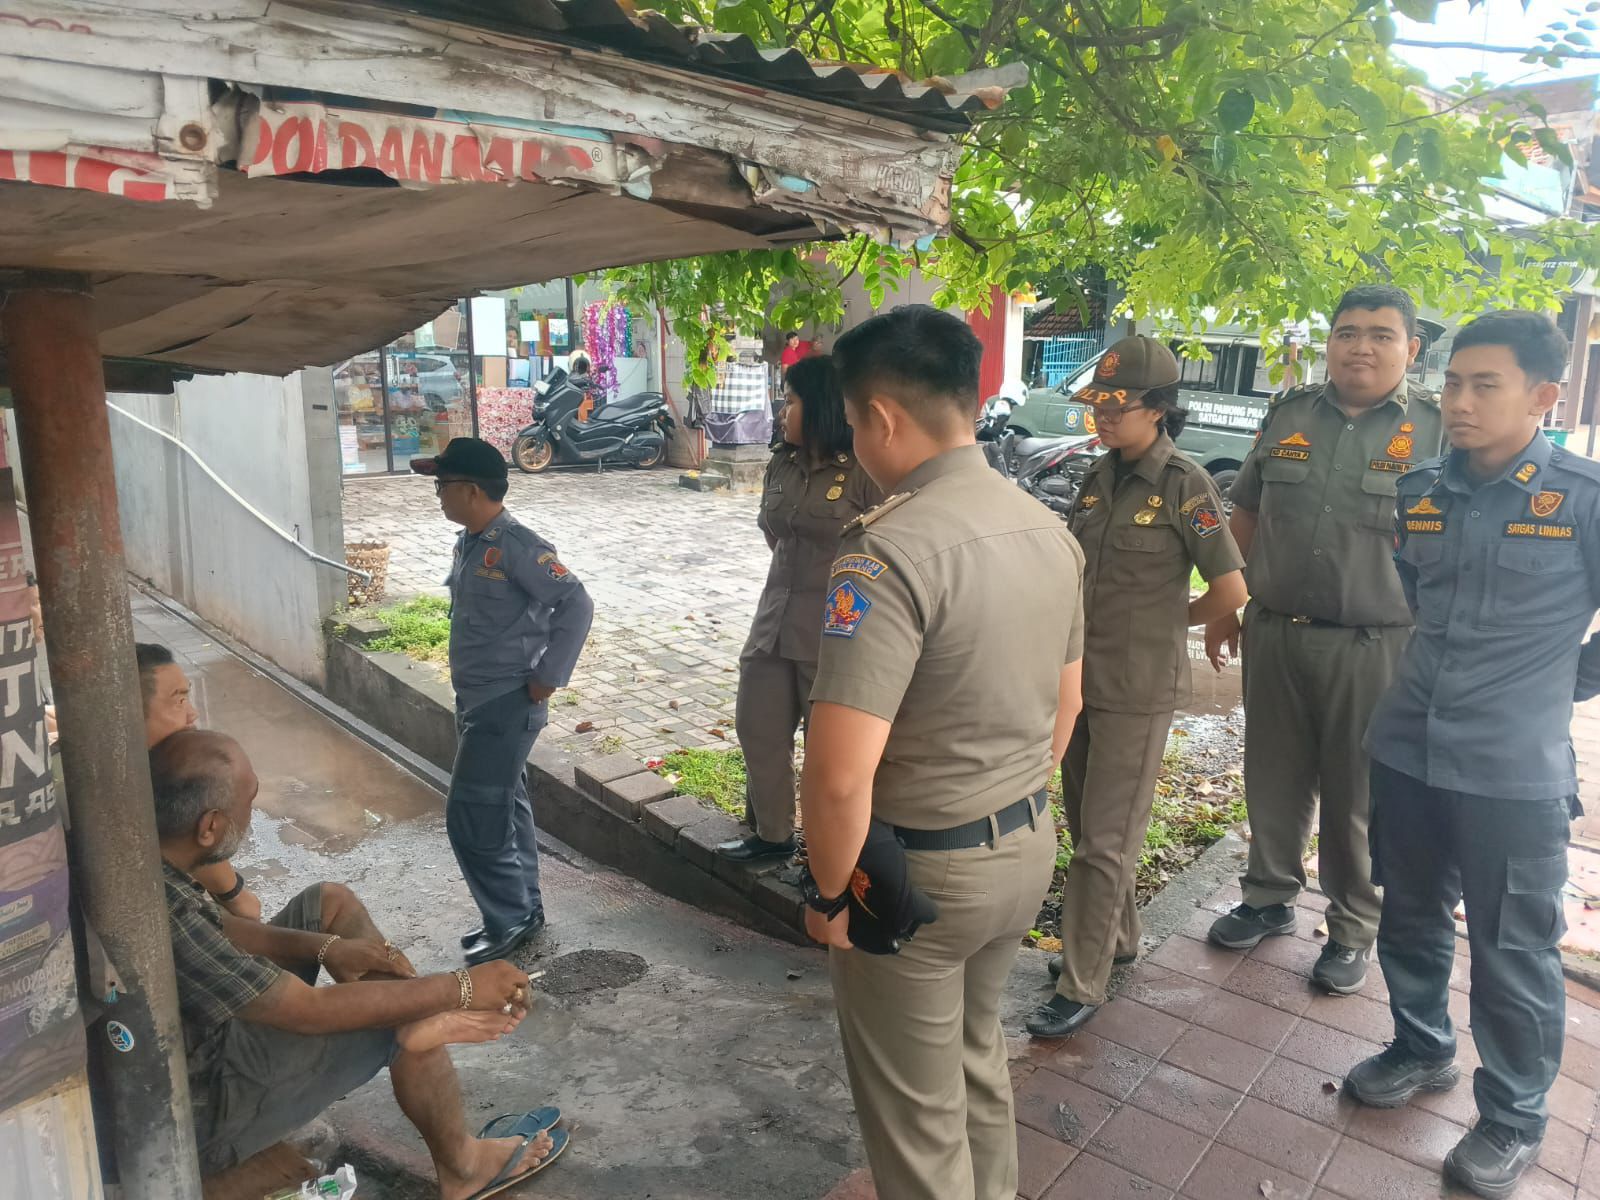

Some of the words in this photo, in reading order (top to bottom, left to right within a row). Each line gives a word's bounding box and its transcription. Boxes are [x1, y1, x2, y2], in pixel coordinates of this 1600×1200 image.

[1188, 400, 1212, 412] POLISI
[1246, 407, 1269, 419] PRAJ
[1198, 412, 1228, 425] SATGAS
[1406, 520, 1443, 532] DENNIS
[1507, 523, 1536, 535] SATGAS
[1538, 524, 1573, 537] LINMAS
